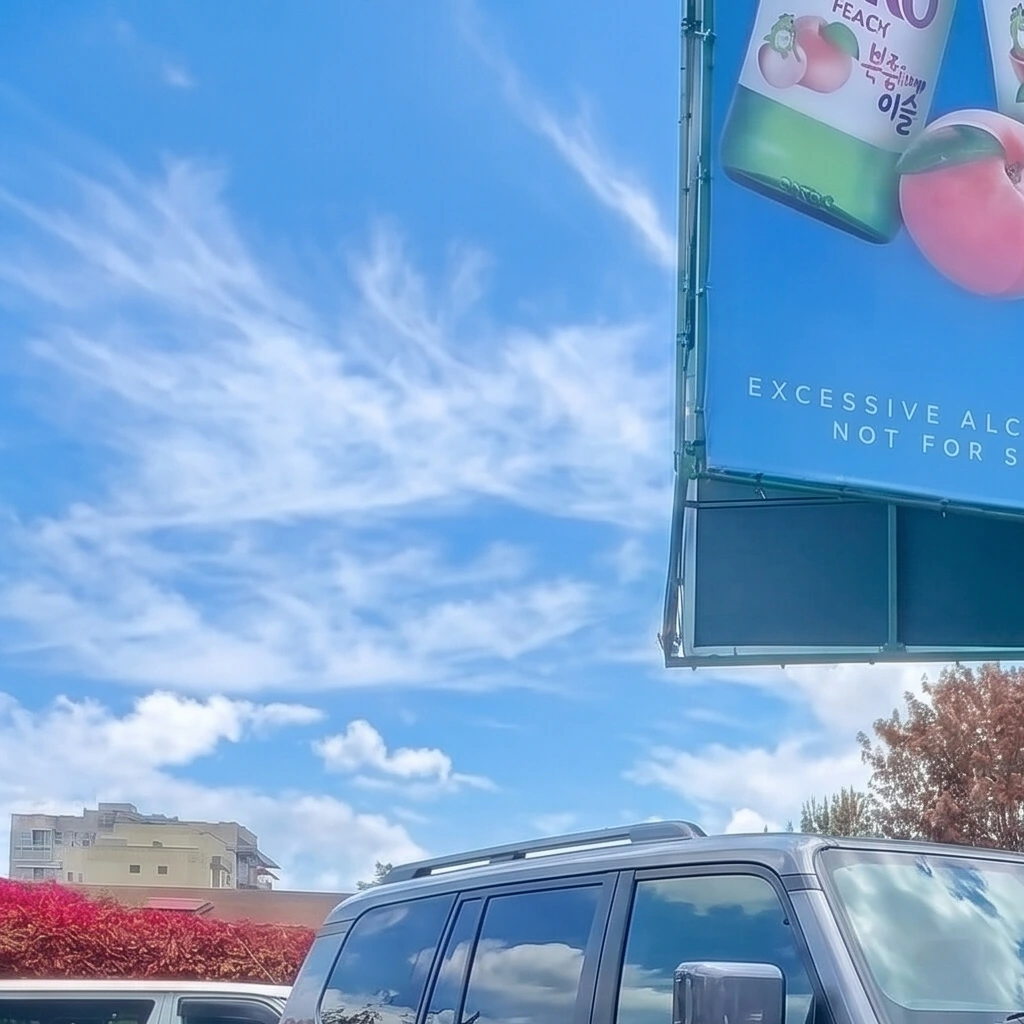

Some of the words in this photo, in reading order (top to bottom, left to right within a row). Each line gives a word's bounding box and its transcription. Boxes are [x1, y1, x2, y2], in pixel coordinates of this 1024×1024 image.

[878, 93, 917, 136] 이슬
[749, 377, 939, 425] EXCESSIVE
[833, 421, 899, 448] NOT
[922, 435, 982, 461] FOR
